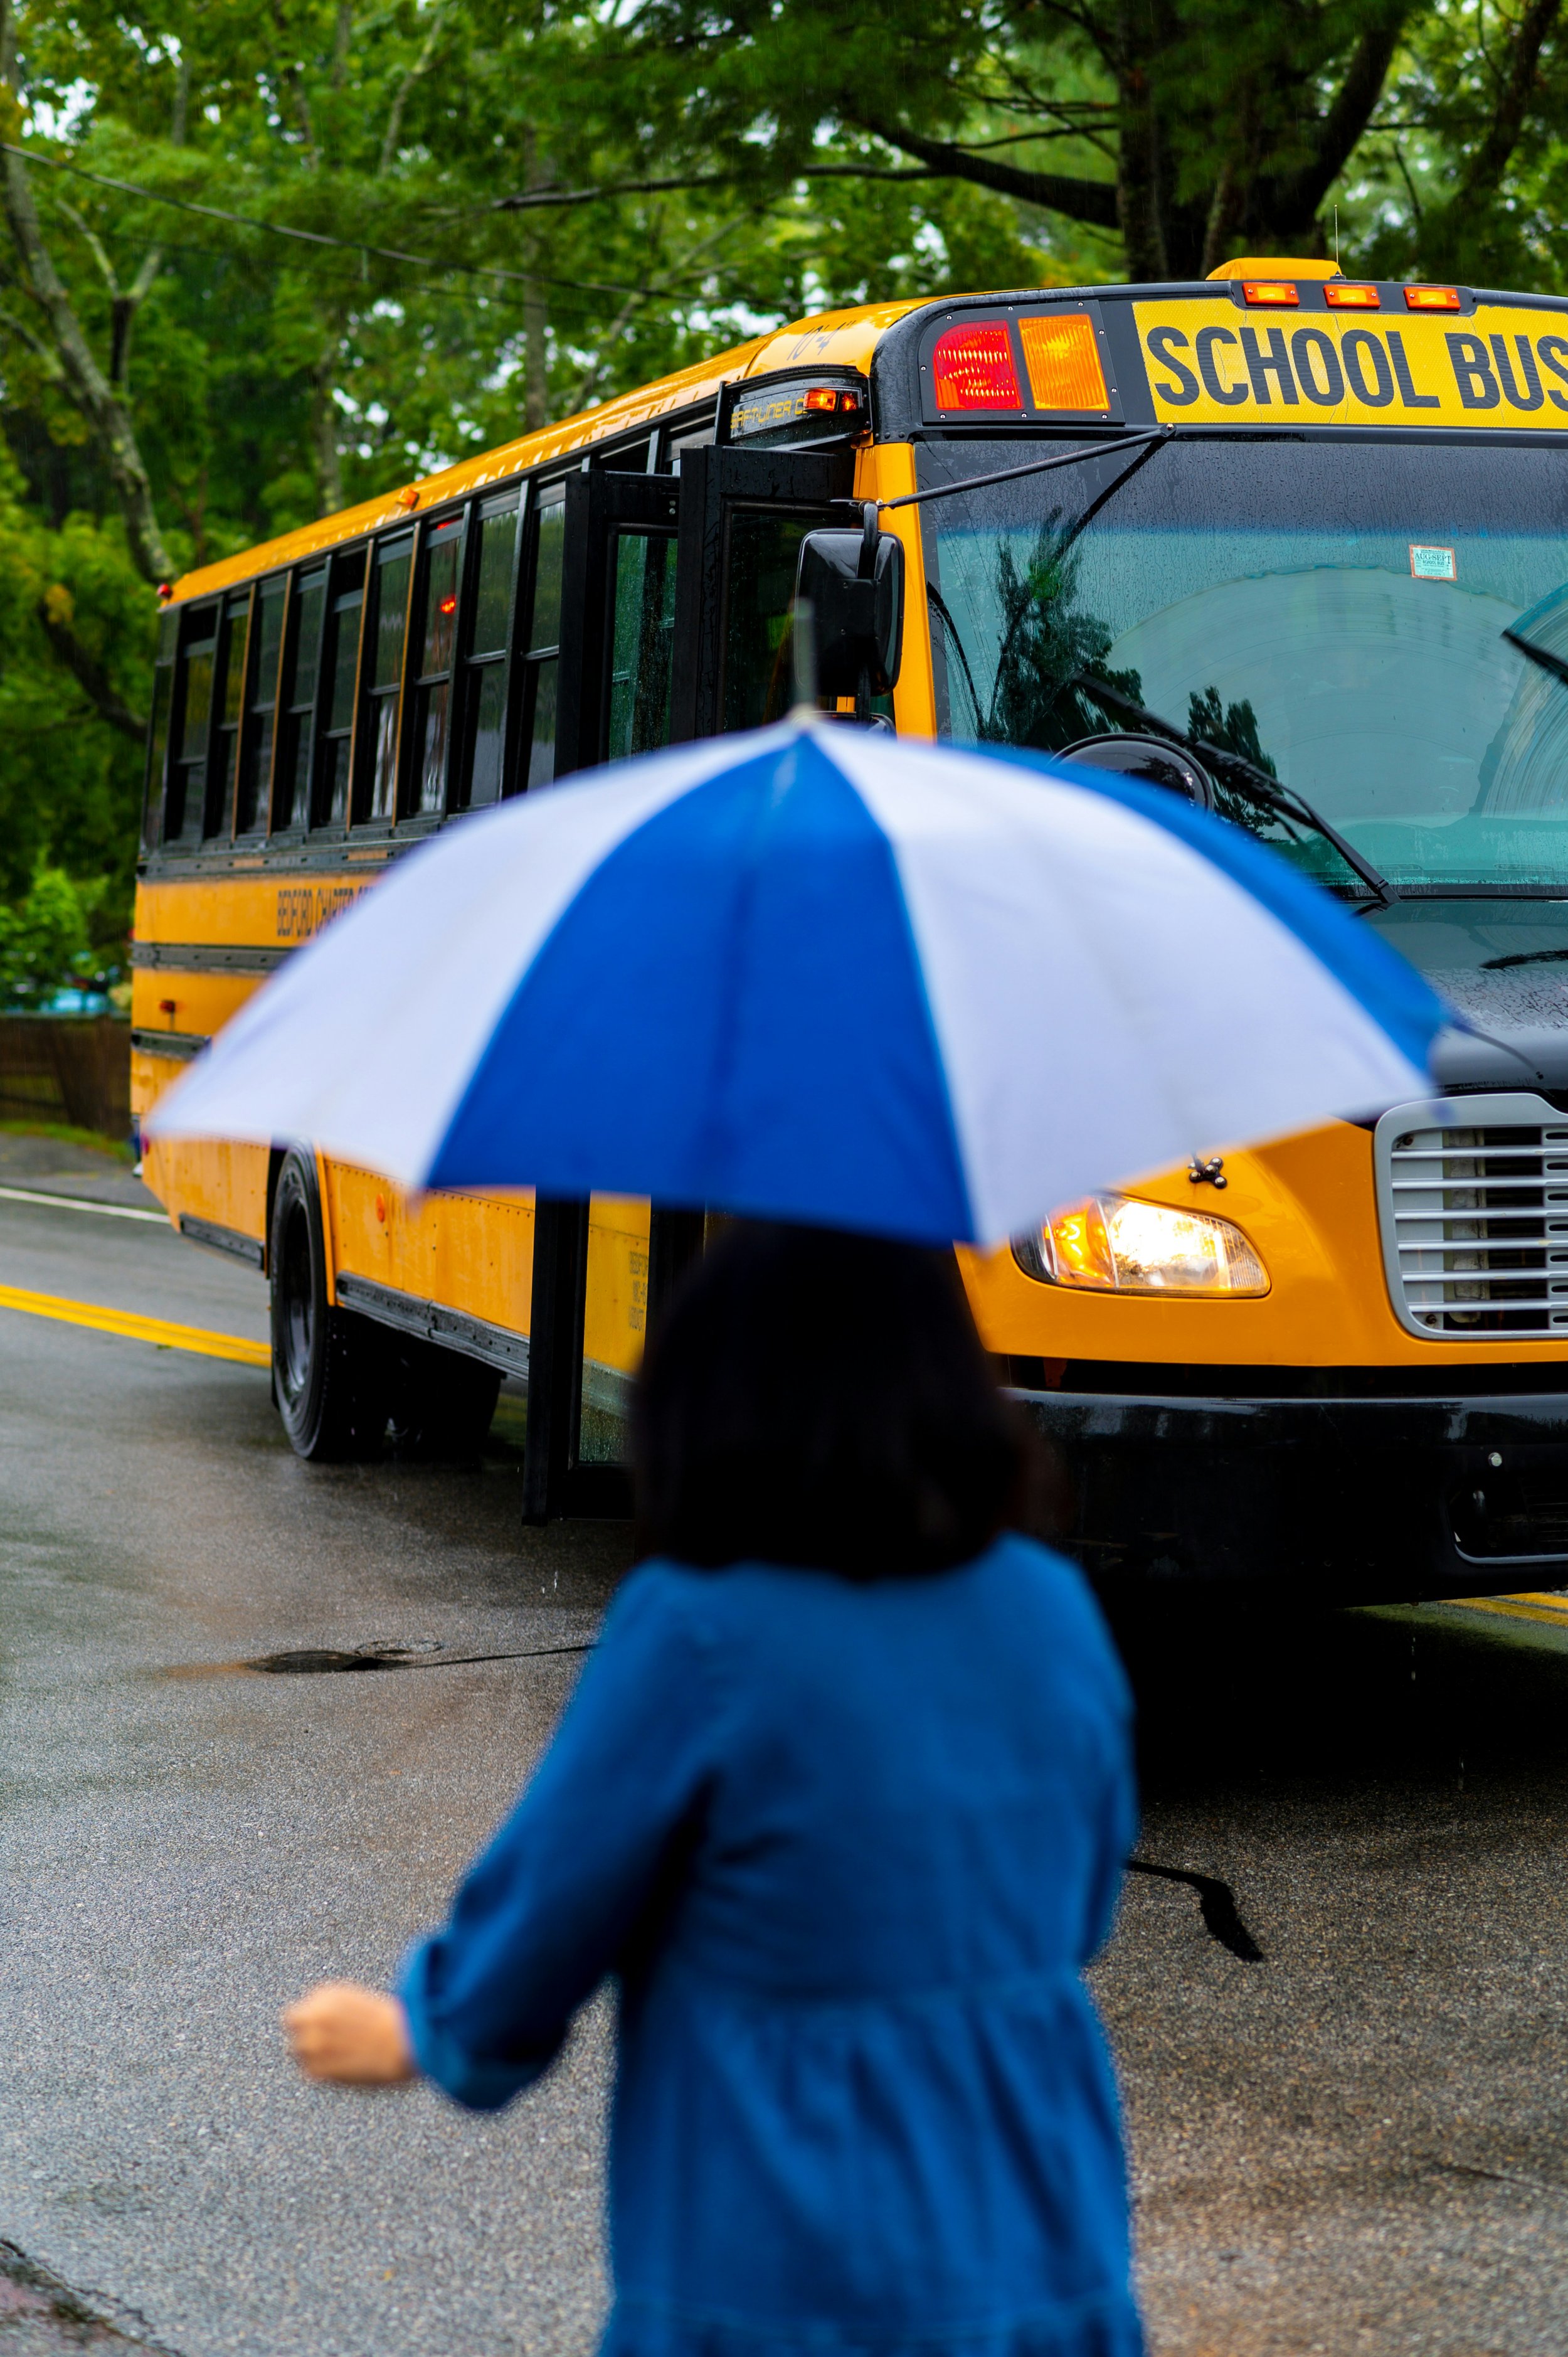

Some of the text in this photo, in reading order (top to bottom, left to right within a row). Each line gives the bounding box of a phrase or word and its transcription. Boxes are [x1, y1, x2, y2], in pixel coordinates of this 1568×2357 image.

[1147, 326, 1568, 412] SCHOOL BUS
[278, 888, 313, 937] BEDFORD
